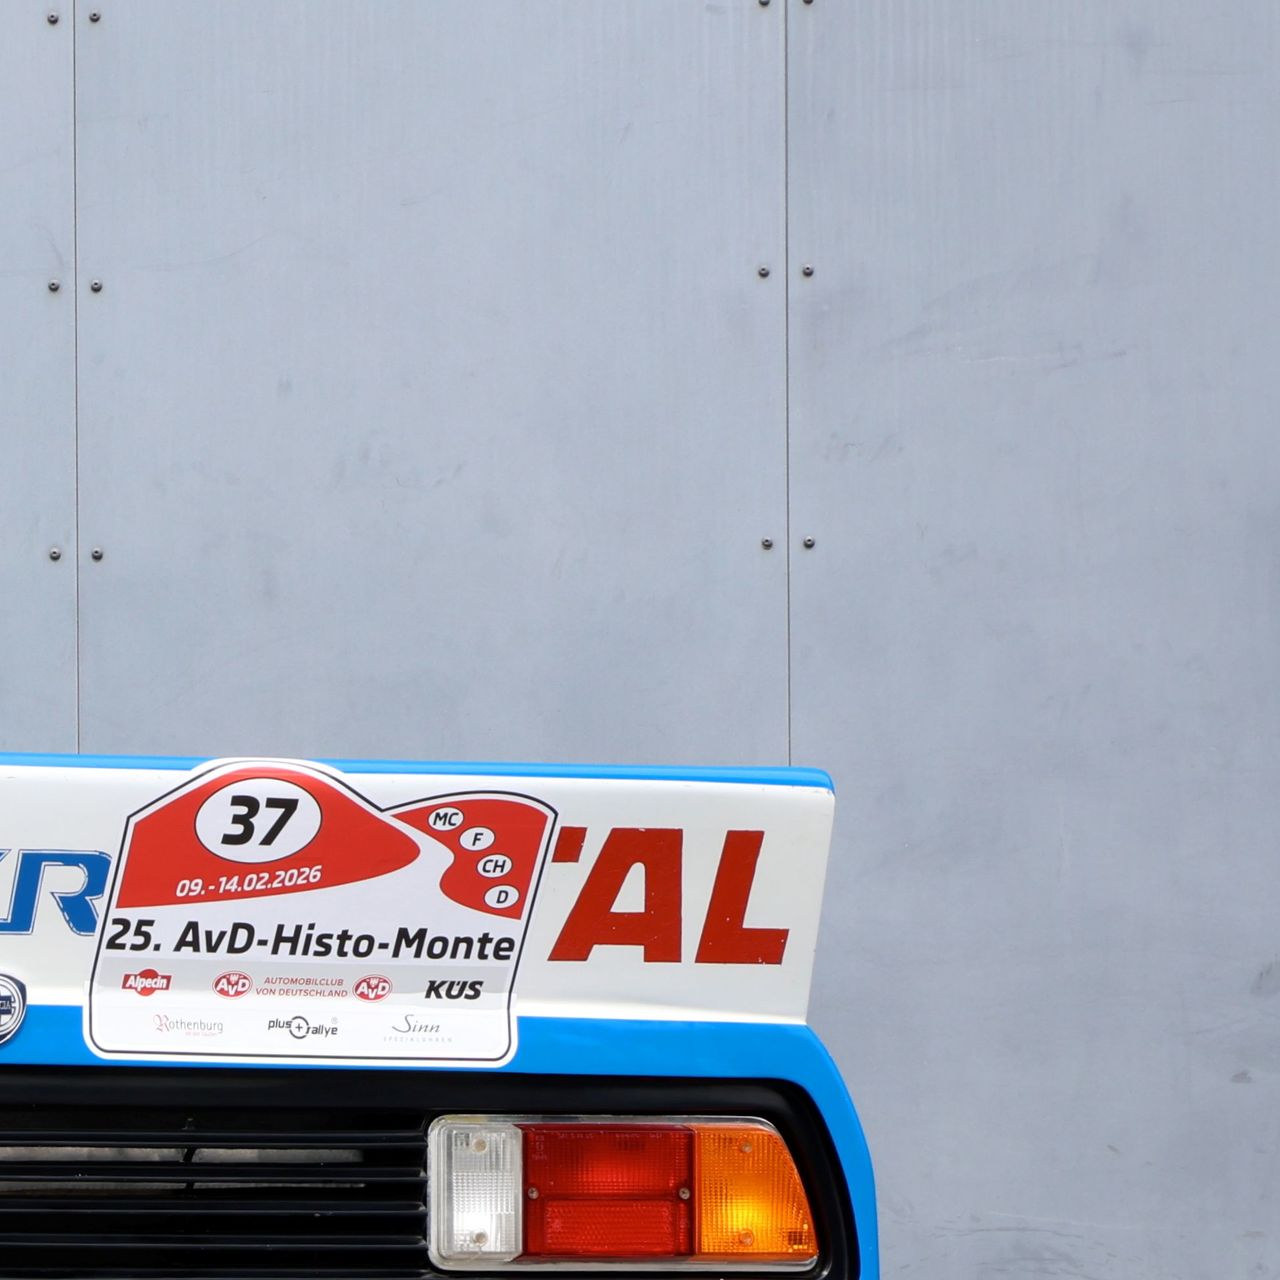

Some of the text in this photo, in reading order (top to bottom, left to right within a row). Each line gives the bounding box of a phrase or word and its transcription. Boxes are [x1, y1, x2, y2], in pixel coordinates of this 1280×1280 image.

[221, 794, 299, 847] 37
[433, 812, 460, 828] MC
[471, 831, 485, 847] F
[482, 858, 508, 876] CH
[495, 888, 510, 905] D
[104, 917, 517, 961] 25. AvD-Histo-Monte
[125, 974, 168, 990] Alpecin
[263, 975, 345, 987] AUTOMOBILCLUB
[424, 979, 484, 1000] KÜS
[255, 987, 349, 999] VON DEUTSCHLAND
[153, 1013, 224, 1034] Rothenburg
[392, 1013, 441, 1034] Sinn
